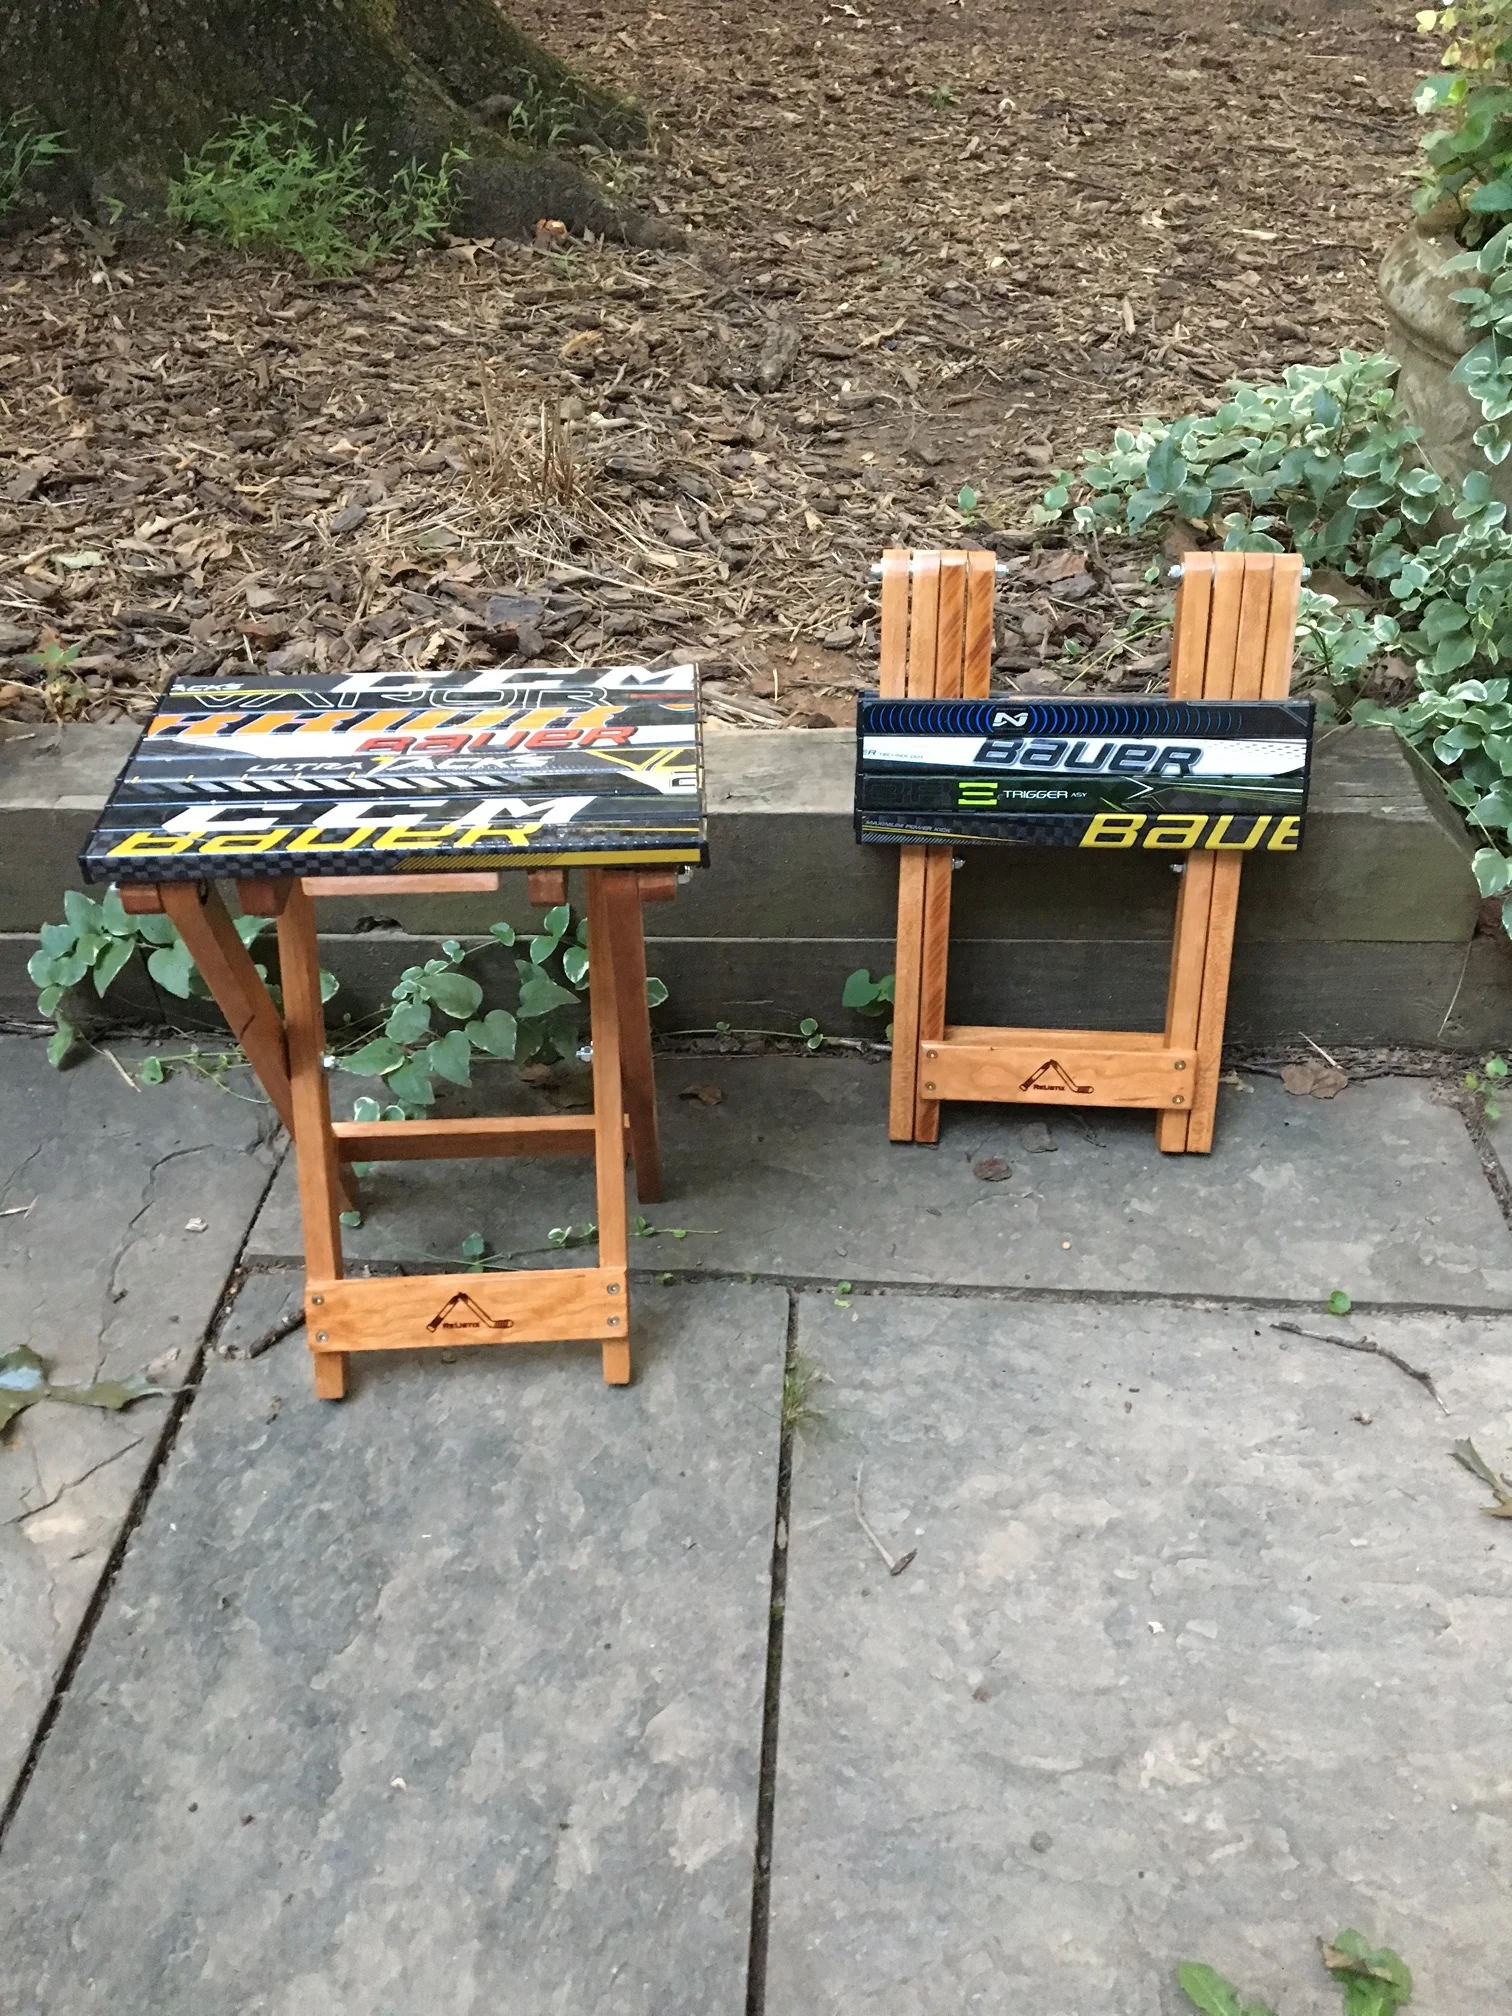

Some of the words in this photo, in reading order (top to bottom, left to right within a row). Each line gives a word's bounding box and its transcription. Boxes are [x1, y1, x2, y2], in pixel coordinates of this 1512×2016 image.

[331, 666, 694, 692] CCM
[245, 761, 363, 774] ULTRA
[1002, 789, 1068, 799] TRIGGER
[161, 796, 597, 833] CCM
[864, 820, 904, 829] MAXIMUM
[905, 823, 933, 832] POWER
